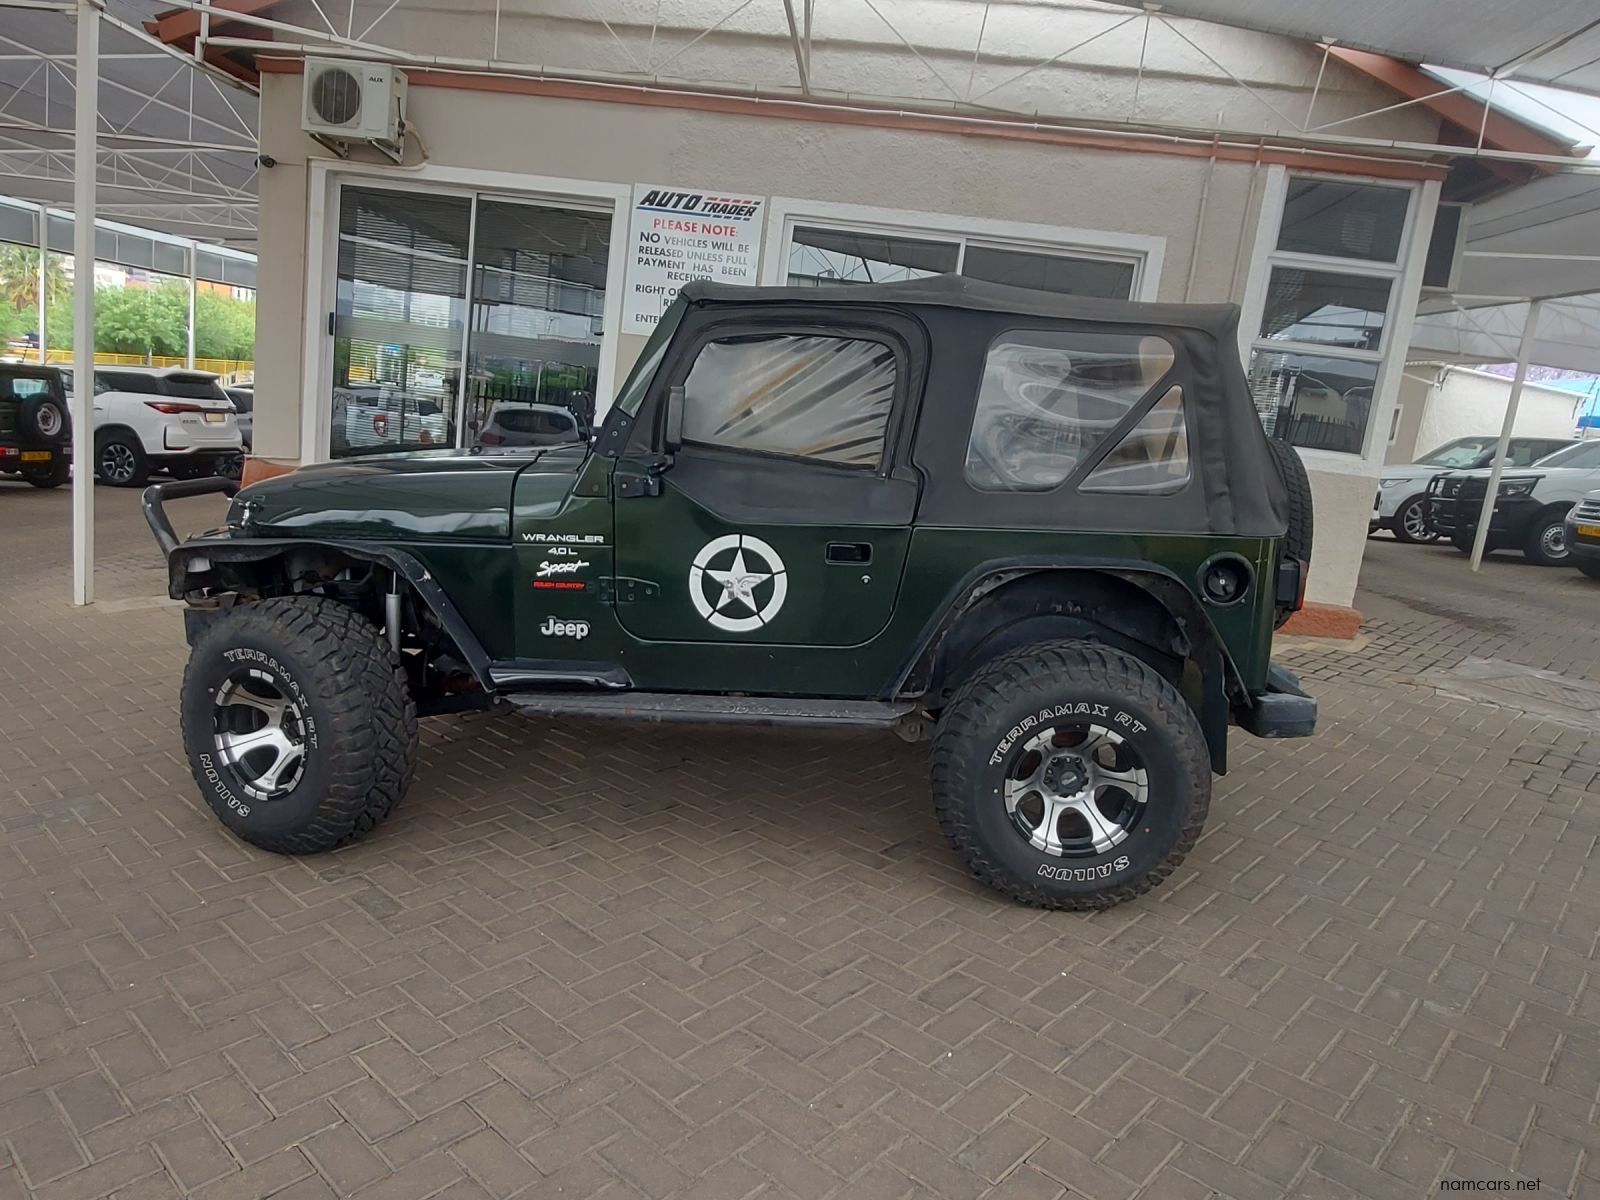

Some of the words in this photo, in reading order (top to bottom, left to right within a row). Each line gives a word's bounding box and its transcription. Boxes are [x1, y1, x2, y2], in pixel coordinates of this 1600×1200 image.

[639, 189, 703, 211] AUTO
[700, 202, 757, 217] TRADER
[653, 218, 697, 233] PLEASE
[701, 224, 738, 237] NOTE:
[640, 232, 660, 243] NO
[664, 236, 708, 249] VEHICLES
[711, 241, 734, 252] WILL
[738, 244, 749, 253] BE
[638, 245, 683, 258] RELEASED
[687, 251, 723, 263] UNLESS
[726, 255, 748, 265] FULL
[637, 257, 686, 270] PAYMENT
[693, 262, 714, 273] HAS
[721, 266, 747, 277] BEEN
[635, 284, 666, 295] RIGHT
[522, 533, 604, 543] WRANGLER
[541, 618, 589, 640] Jeep
[223, 648, 309, 710] TERRAMAX
[306, 716, 318, 749] RT
[989, 702, 1109, 766] TERRAMAX
[1114, 711, 1147, 734] RT
[200, 753, 250, 817] SAILUN
[1037, 855, 1130, 881] SAILUN
